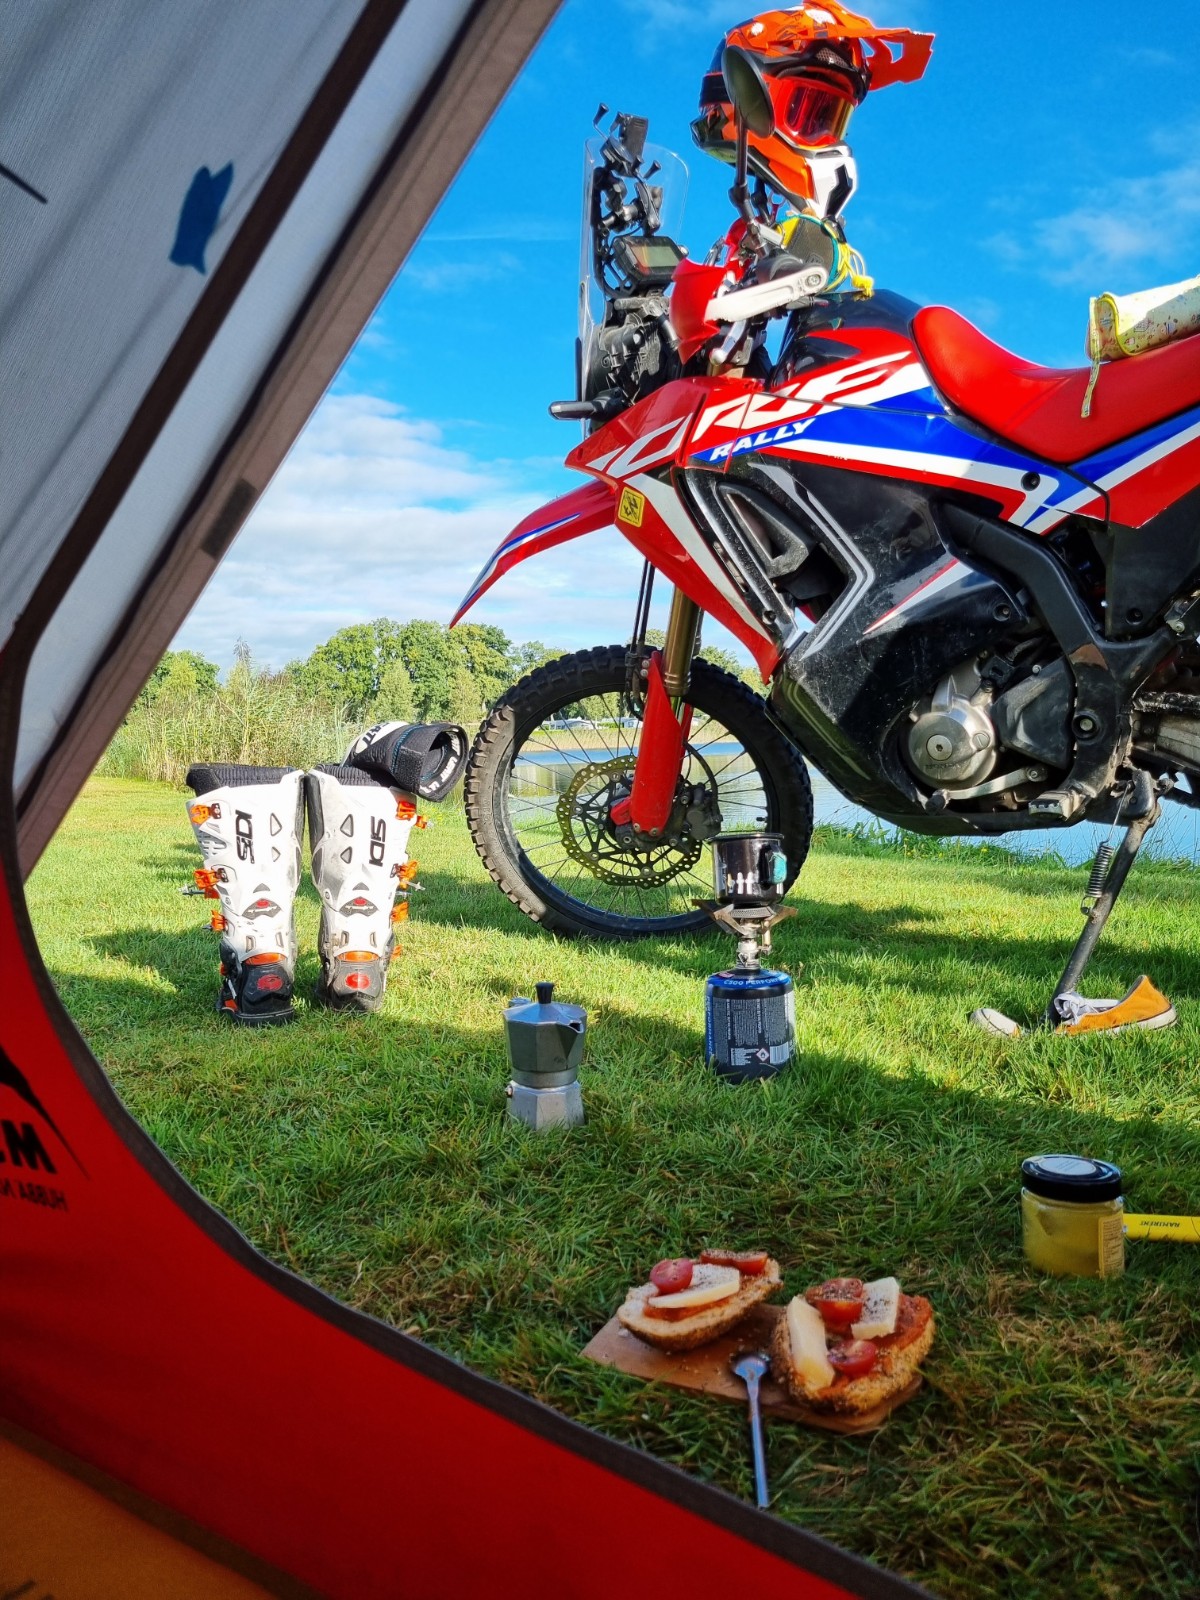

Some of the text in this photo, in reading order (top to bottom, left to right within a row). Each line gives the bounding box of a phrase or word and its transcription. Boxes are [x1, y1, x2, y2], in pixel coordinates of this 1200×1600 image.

[709, 417, 816, 463] RALLY
[234, 809, 255, 865] SIDI
[369, 816, 387, 867] SIDI
